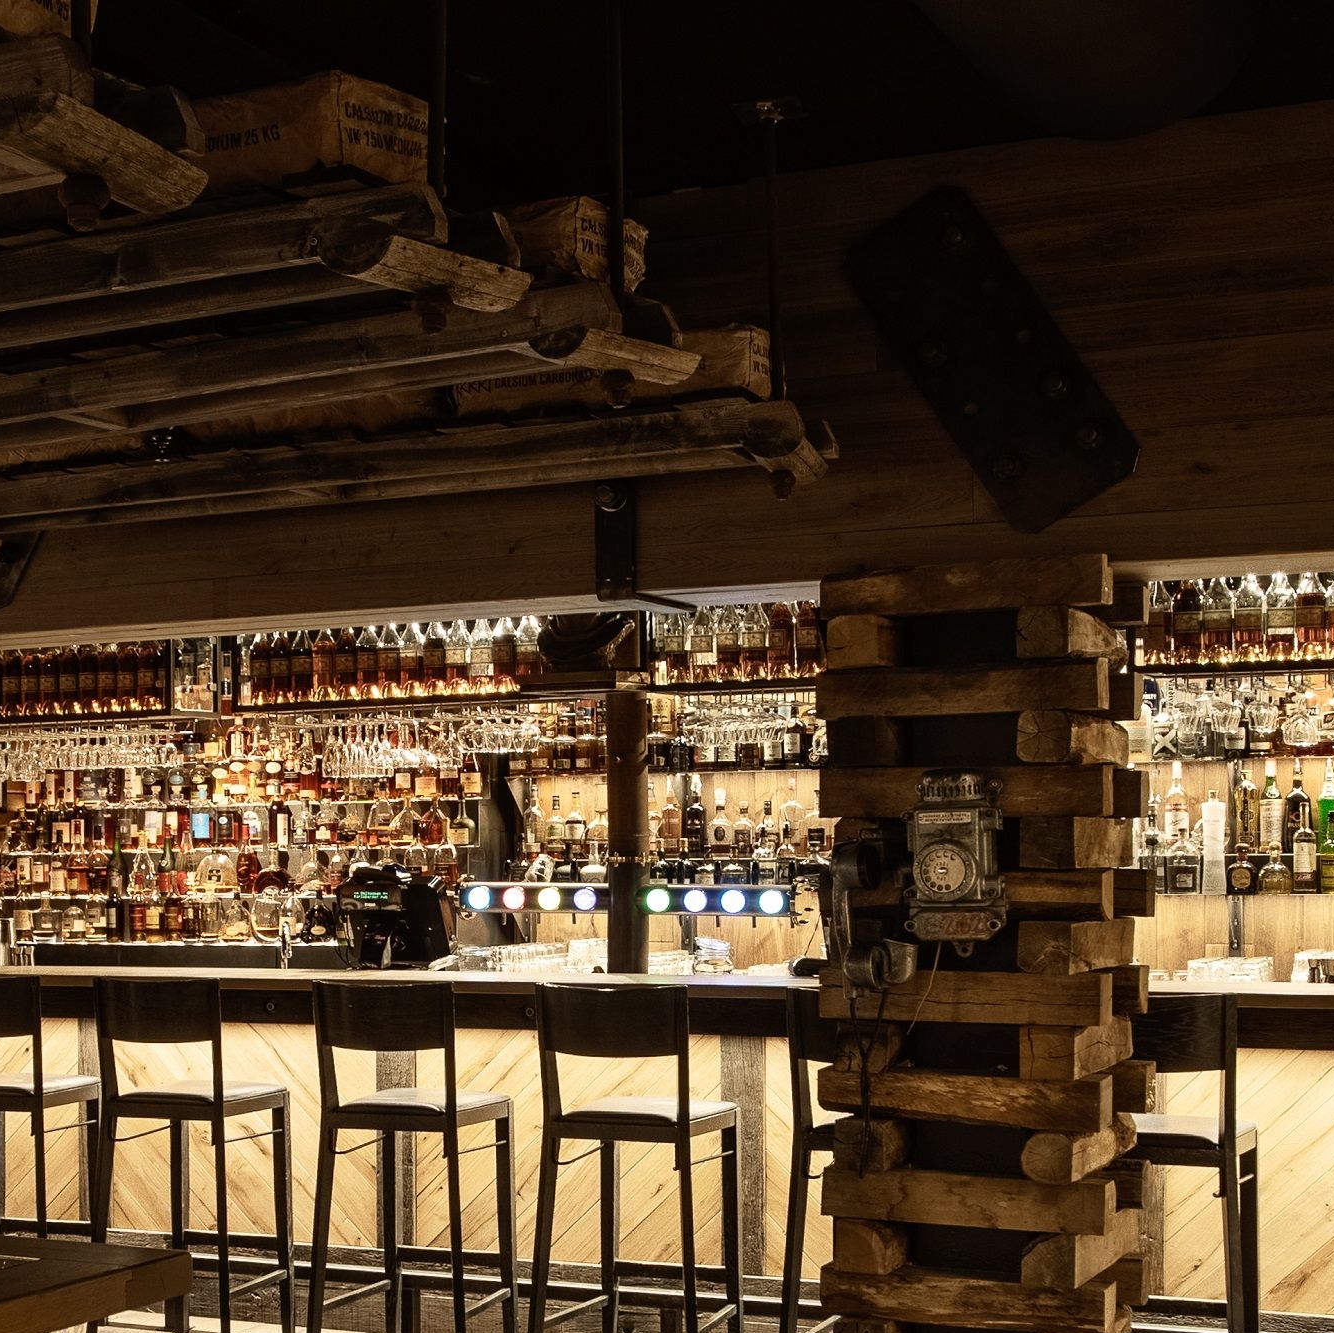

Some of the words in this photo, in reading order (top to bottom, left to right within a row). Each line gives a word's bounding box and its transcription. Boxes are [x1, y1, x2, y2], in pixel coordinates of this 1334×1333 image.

[244, 130, 260, 147] 25
[262, 124, 281, 143] KG
[345, 126, 361, 146] VK
[365, 128, 384, 149] 150
[382, 134, 424, 159] MEDIUM
[494, 375, 537, 389] CALSIUM
